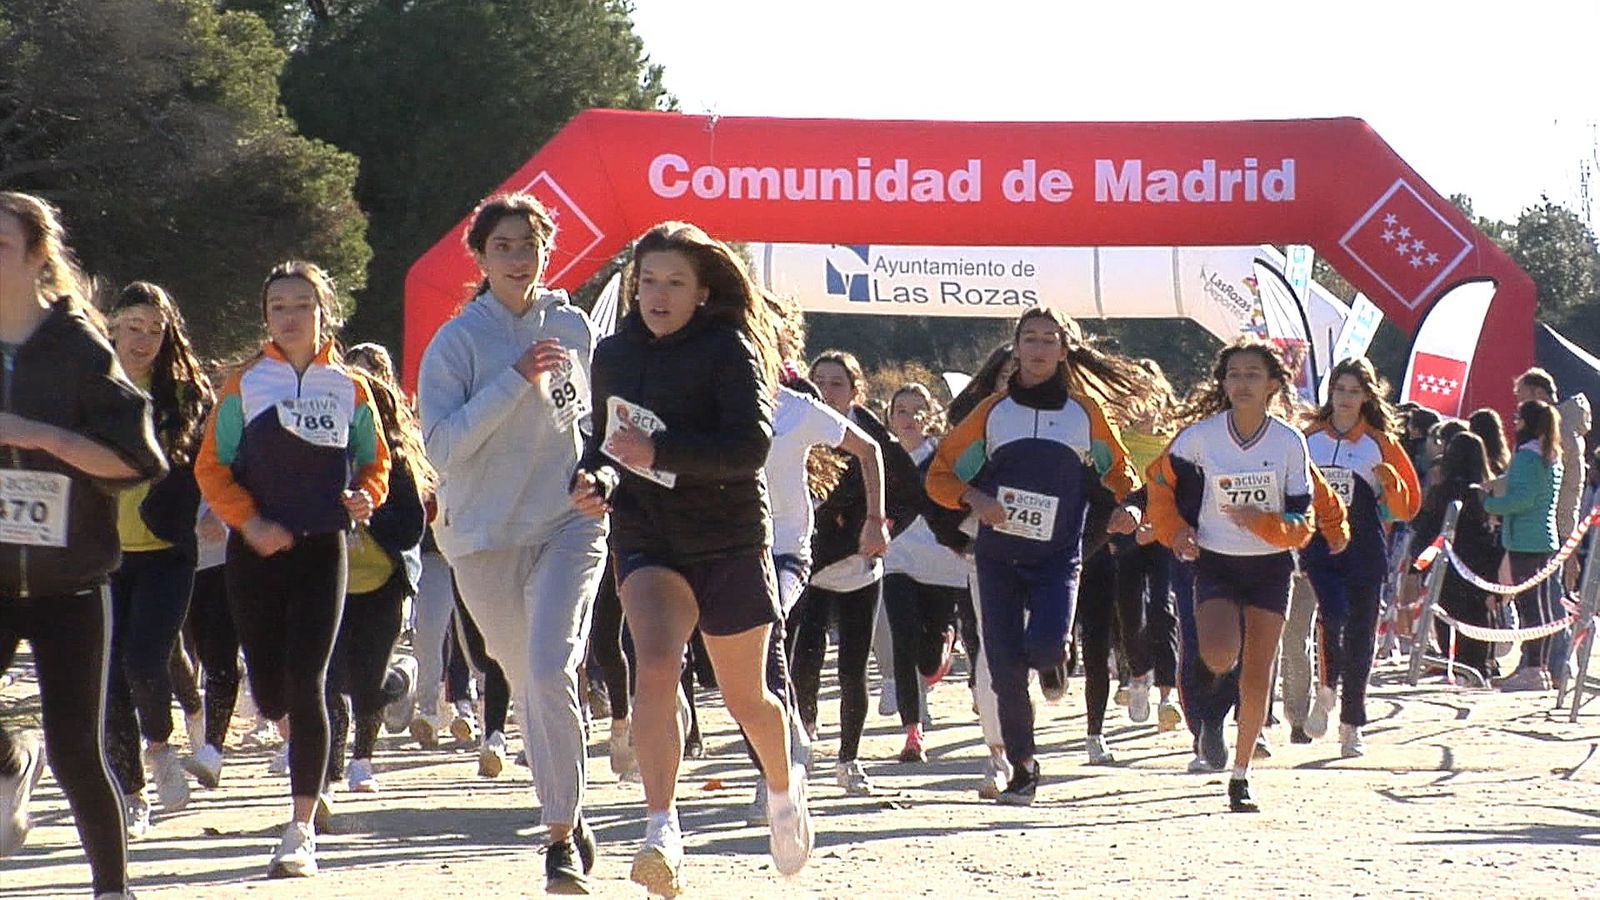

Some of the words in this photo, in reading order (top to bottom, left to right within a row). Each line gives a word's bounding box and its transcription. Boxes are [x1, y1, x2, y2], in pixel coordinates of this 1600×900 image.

[648, 153, 982, 203] Comunidad
[1002, 159, 1074, 203] de
[1094, 158, 1296, 203] Madrid
[874, 256, 1006, 278] Ayuntamiento
[1006, 260, 1035, 277] de
[873, 279, 929, 304] Las
[940, 281, 1039, 306] Rozas
[1209, 271, 1252, 312] LasRozas
[552, 381, 576, 409] 89
[291, 411, 335, 430] 786
[1234, 474, 1270, 486] activa
[1017, 494, 1052, 508] activa
[1227, 490, 1266, 504] 770
[1007, 506, 1042, 526] 748
